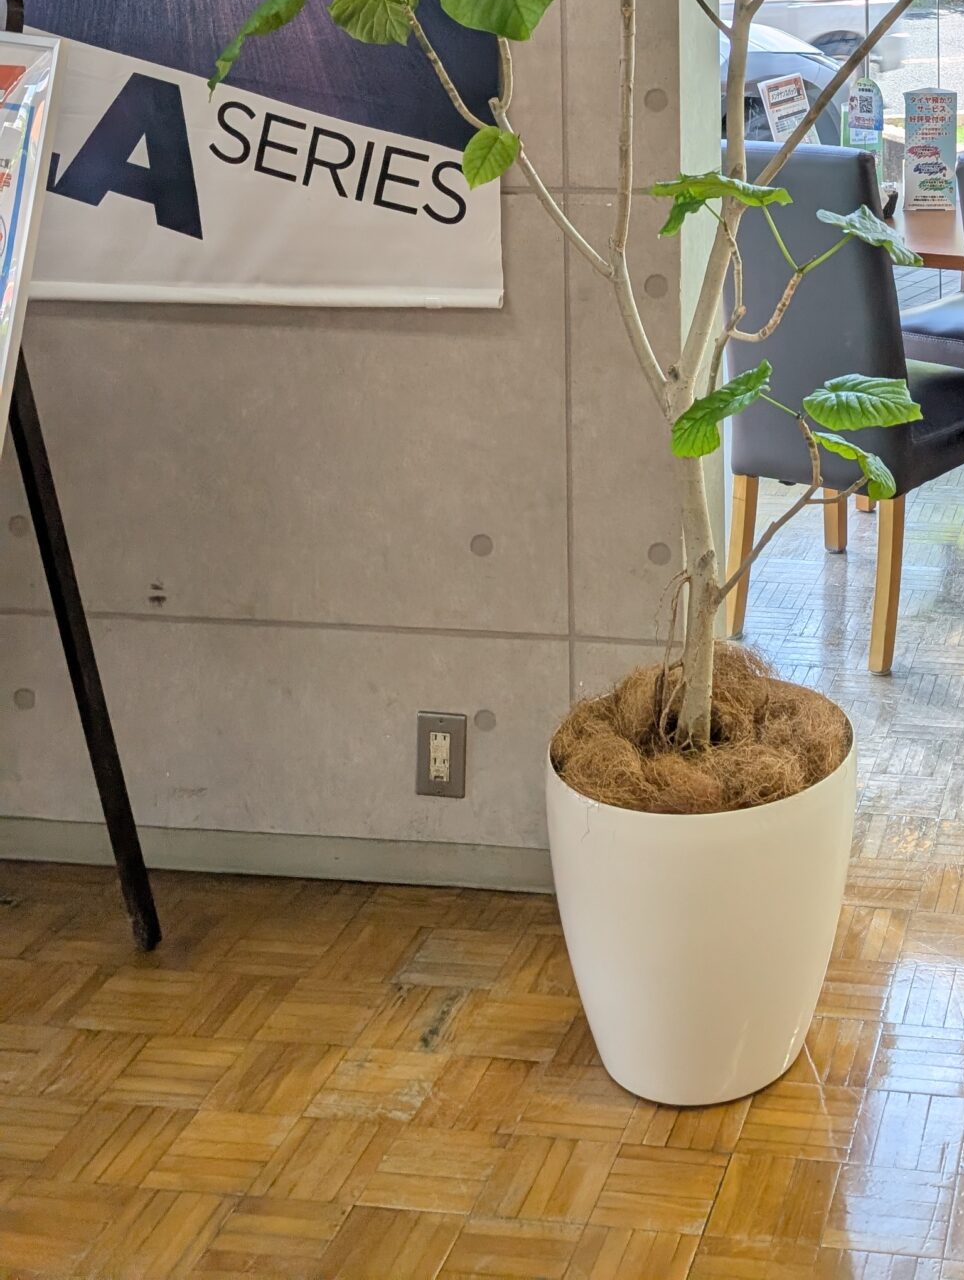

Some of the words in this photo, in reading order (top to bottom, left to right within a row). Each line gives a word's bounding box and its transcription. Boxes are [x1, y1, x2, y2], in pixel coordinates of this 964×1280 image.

[917, 105, 946, 113] サービス
[208, 100, 467, 225] SERIES
